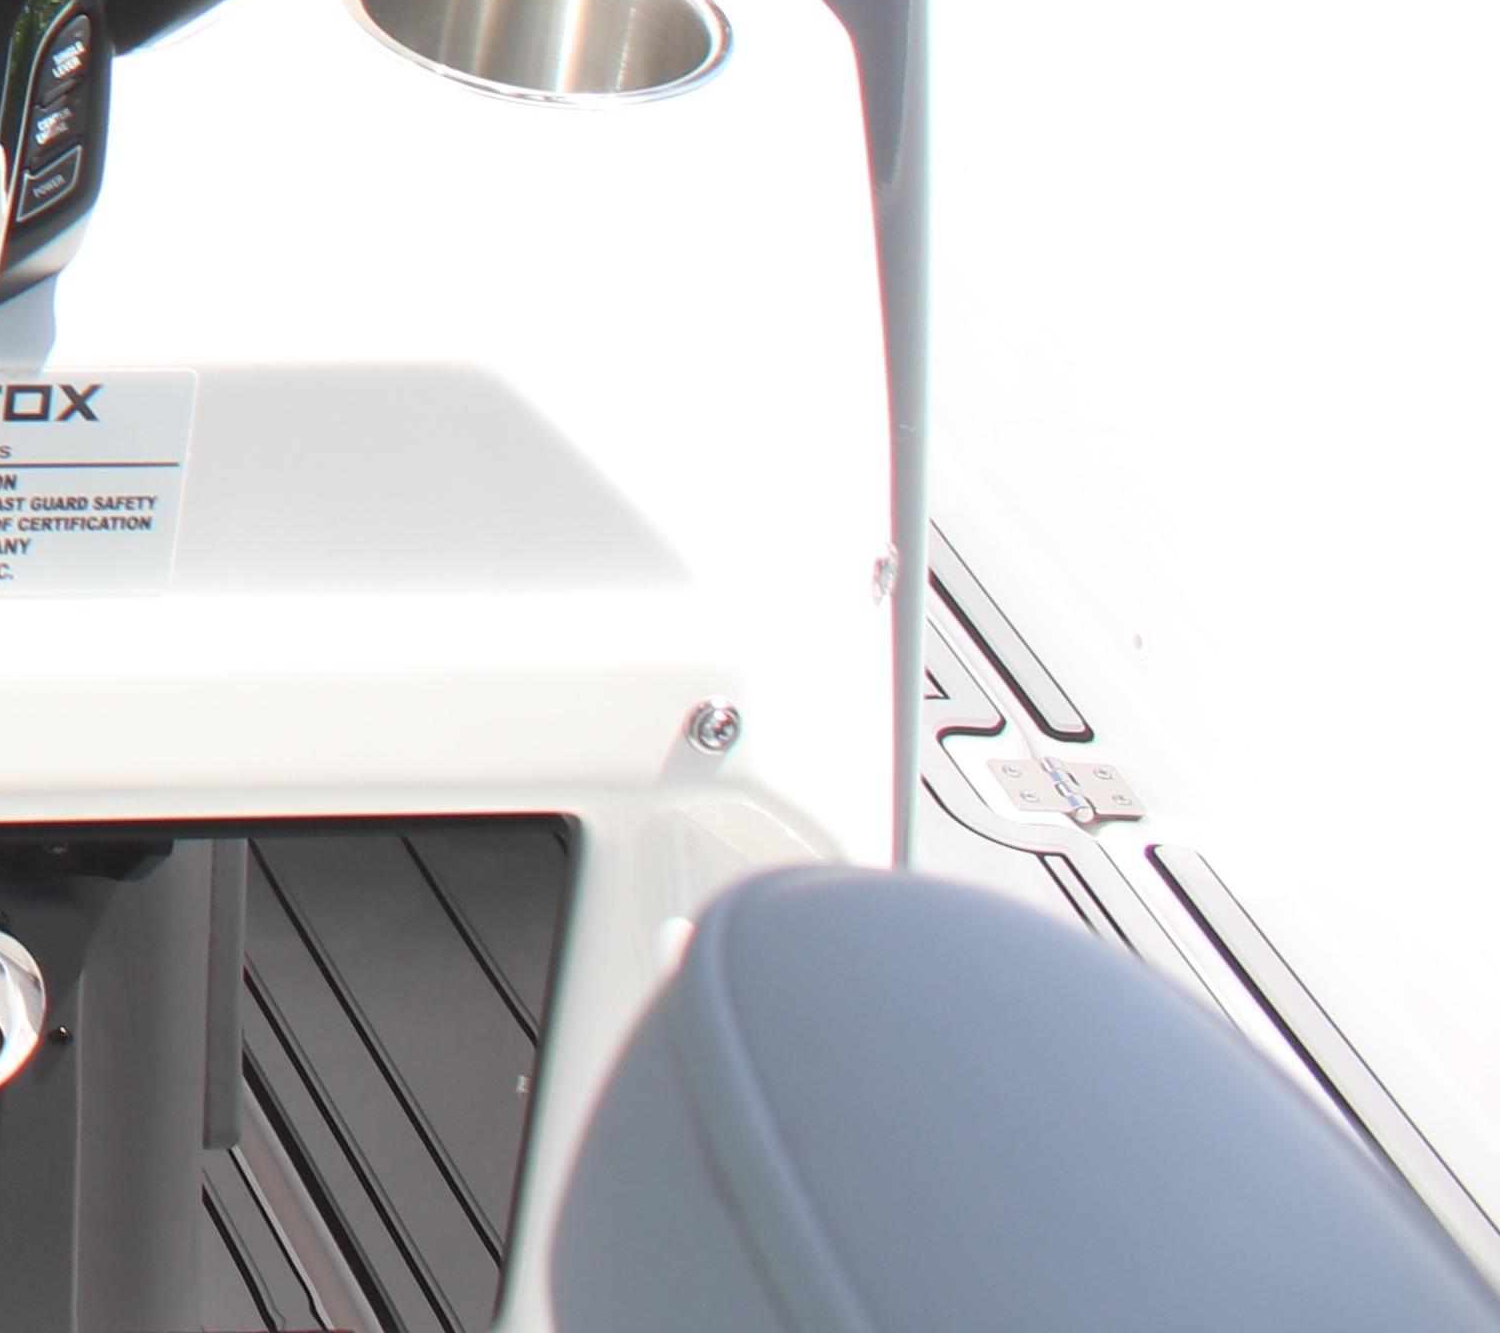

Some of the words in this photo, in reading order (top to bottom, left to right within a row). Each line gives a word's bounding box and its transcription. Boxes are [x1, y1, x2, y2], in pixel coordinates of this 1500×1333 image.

[30, 496, 88, 511] GUARD
[93, 496, 157, 510] SAFETY
[17, 516, 152, 531] CERTIFICATION
